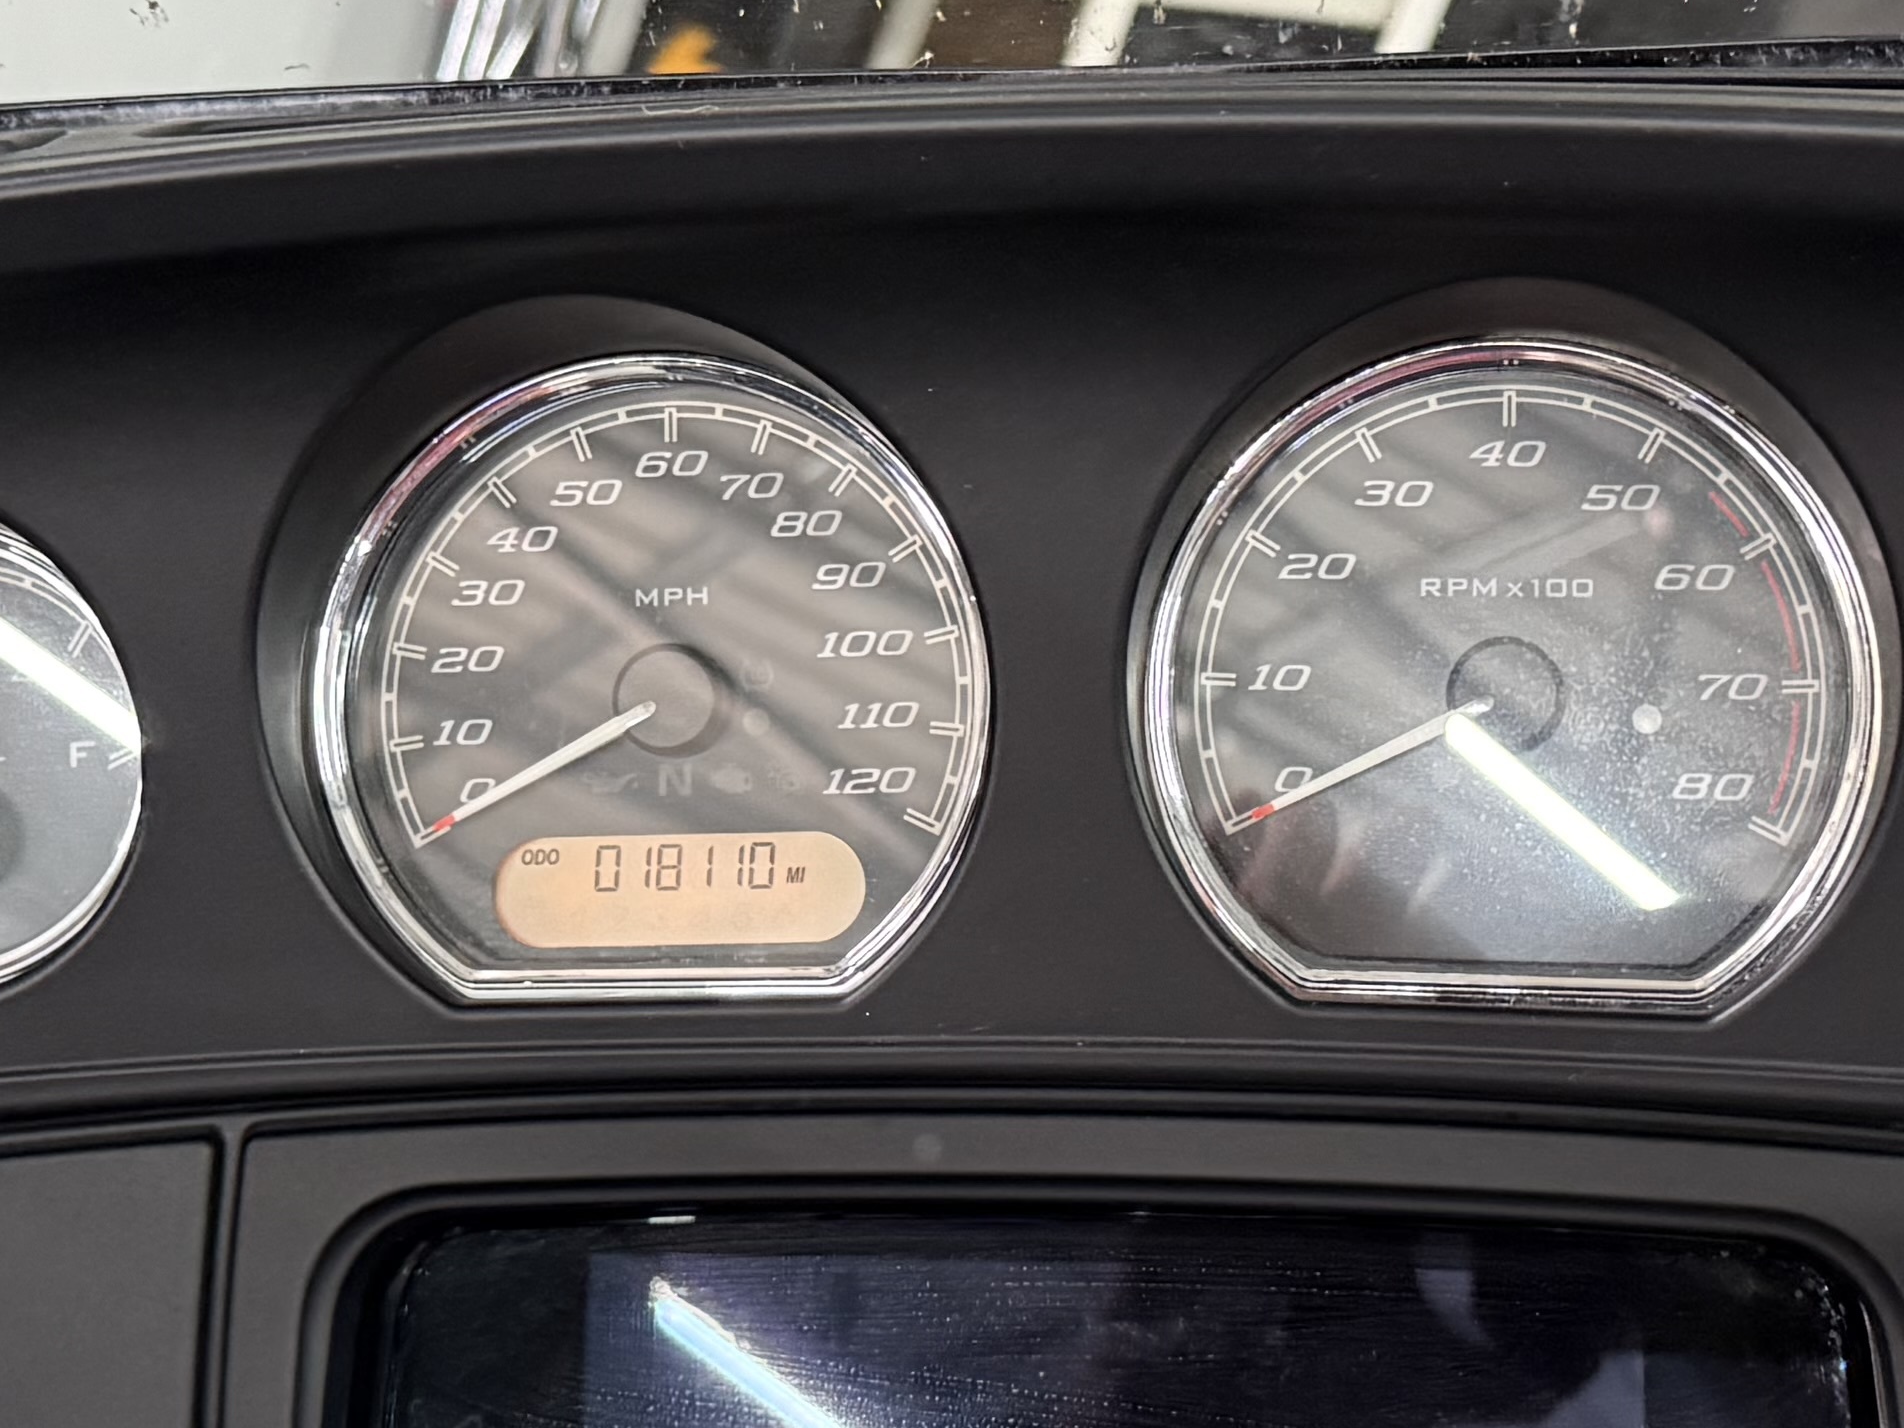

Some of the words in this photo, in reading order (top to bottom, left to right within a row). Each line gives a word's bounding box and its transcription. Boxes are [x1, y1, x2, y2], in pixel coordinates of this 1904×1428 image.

[635, 450, 709, 478] 60
[1469, 440, 1546, 468] 40
[549, 480, 623, 506] 50
[720, 472, 784, 499] 70
[1355, 480, 1434, 507] 30
[1580, 484, 1661, 511] 50
[770, 511, 842, 537] 80
[487, 526, 559, 553] 40
[812, 561, 886, 589] 90
[1278, 553, 1357, 581] 20
[1654, 563, 1735, 591] 60
[451, 580, 525, 606] 30
[634, 587, 708, 607] MPH
[816, 630, 912, 658] 100
[431, 646, 504, 673] 20
[1247, 663, 1311, 691] 10
[1697, 673, 1767, 701] 70
[837, 702, 919, 729] 110
[433, 718, 493, 746] 10
[69, 741, 96, 769] F
[459, 777, 497, 804] 0
[822, 767, 916, 794] 120
[1274, 767, 1313, 793] 0
[1671, 773, 1752, 801] 80
[522, 850, 560, 866] ODO
[594, 842, 775, 891] 018110
[786, 866, 805, 884] MI
